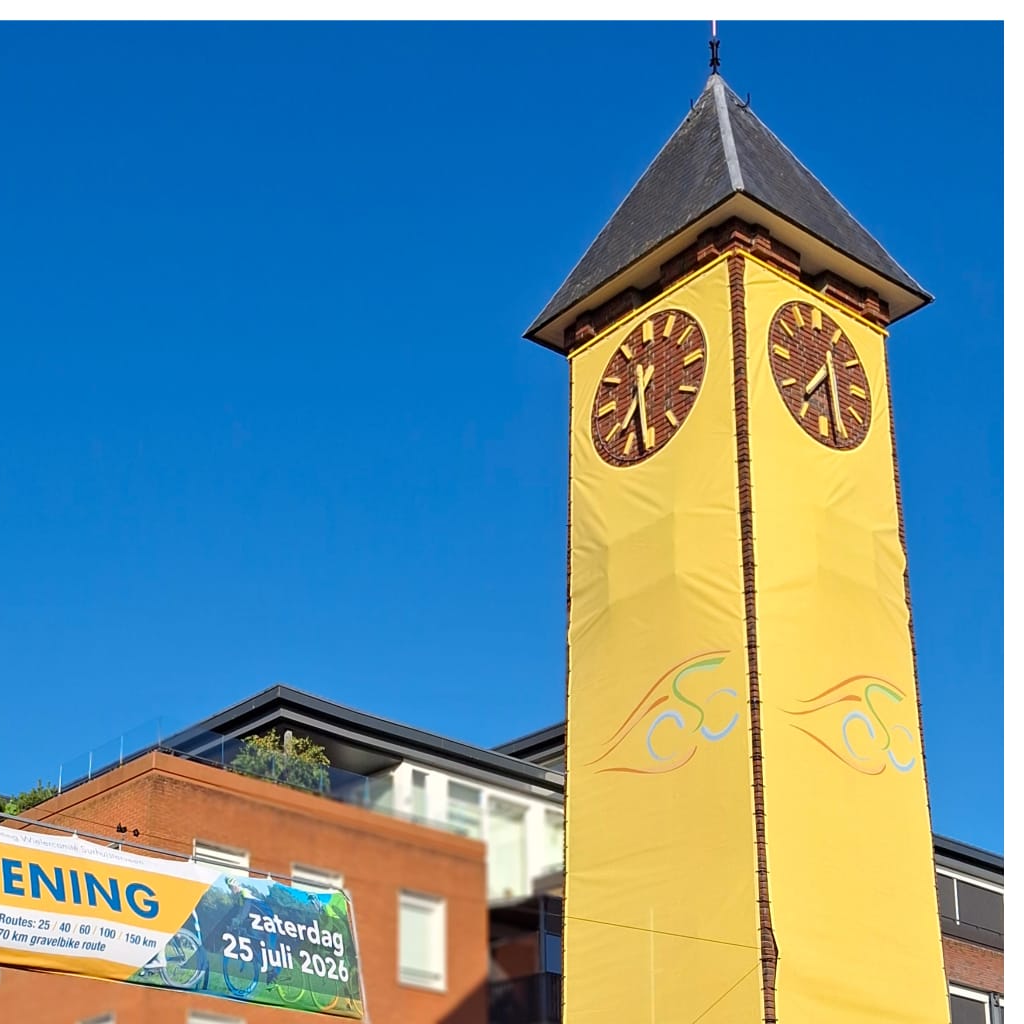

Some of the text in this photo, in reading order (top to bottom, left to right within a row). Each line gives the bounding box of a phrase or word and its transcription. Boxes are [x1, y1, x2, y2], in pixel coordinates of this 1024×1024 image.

[12, 929, 28, 943] km
[29, 932, 80, 950] gravelbike
[82, 941, 106, 952] route
[38, 919, 50, 931] 25
[59, 921, 71, 933] 40
[79, 924, 91, 936] 60
[100, 926, 116, 939] 100
[125, 932, 142, 946] 150
[143, 935, 157, 948] km
[249, 912, 344, 957] zaterdag
[222, 933, 349, 982] 25 juli 2026
